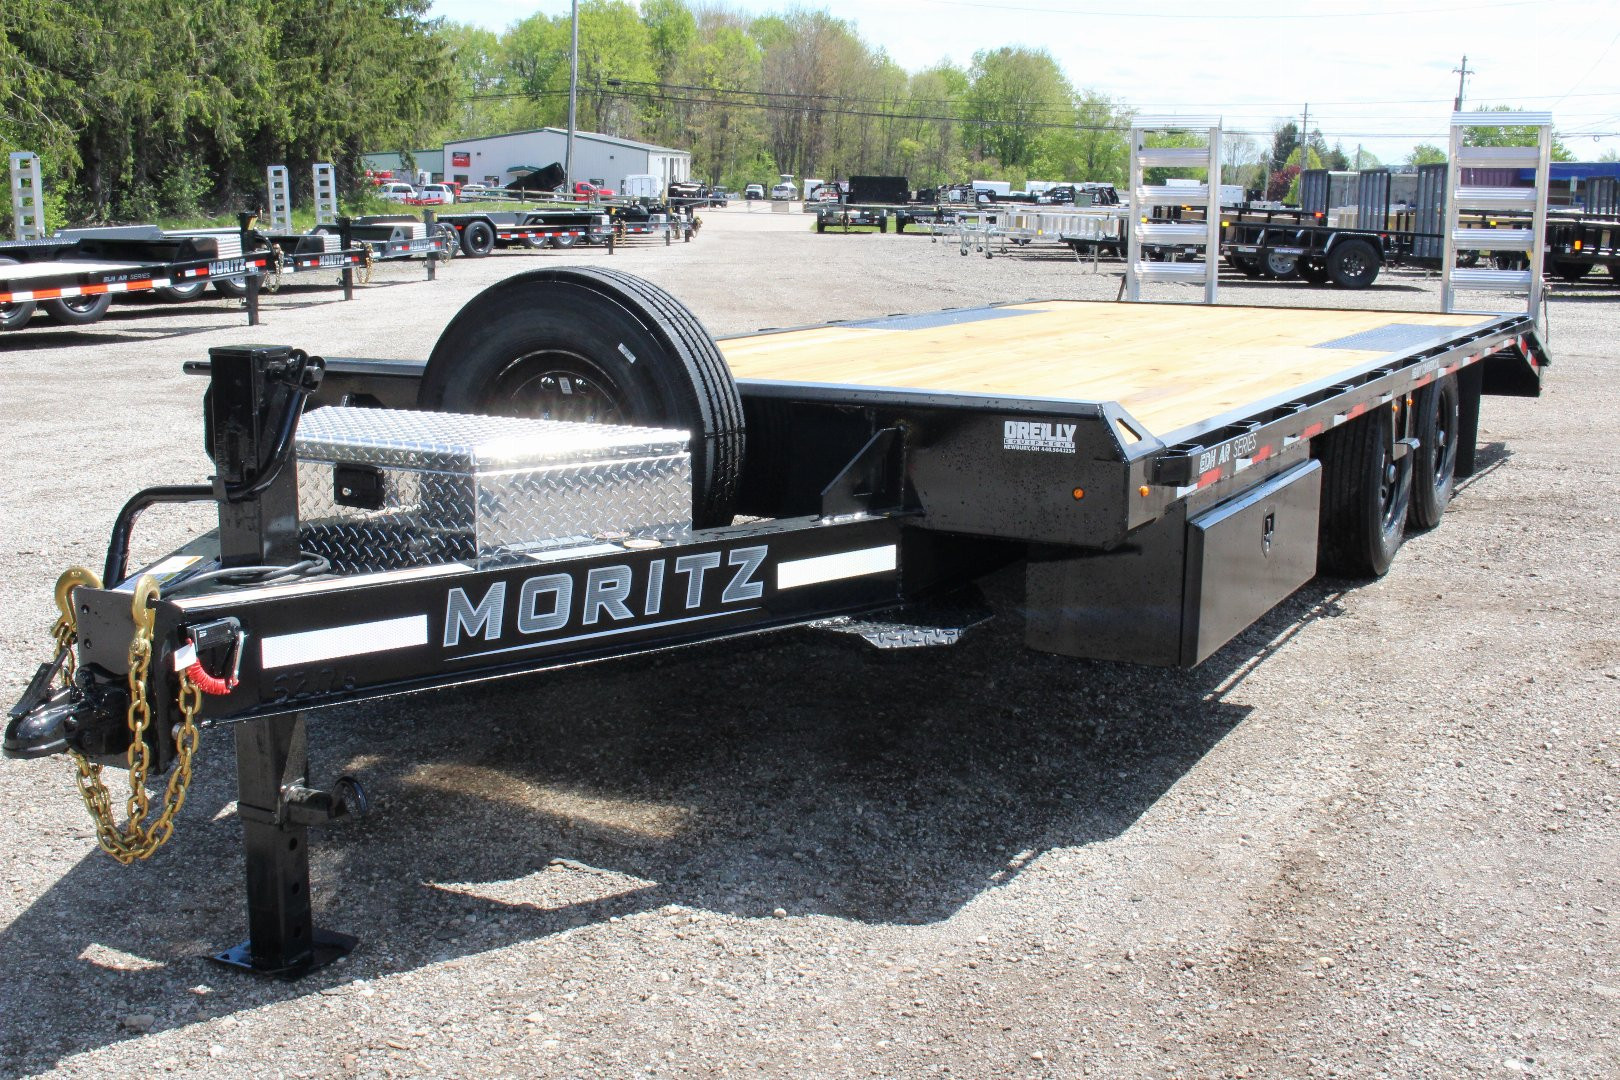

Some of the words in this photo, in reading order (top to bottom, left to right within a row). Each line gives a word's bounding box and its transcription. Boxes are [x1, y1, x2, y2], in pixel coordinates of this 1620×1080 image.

[208, 258, 246, 275] MORITZ
[319, 254, 345, 266] MORITZ
[1004, 438, 1076, 449] EQUIPMENT
[1218, 443, 1231, 465] AR
[1233, 433, 1257, 458] SERIES
[442, 544, 769, 648] MORITZ
